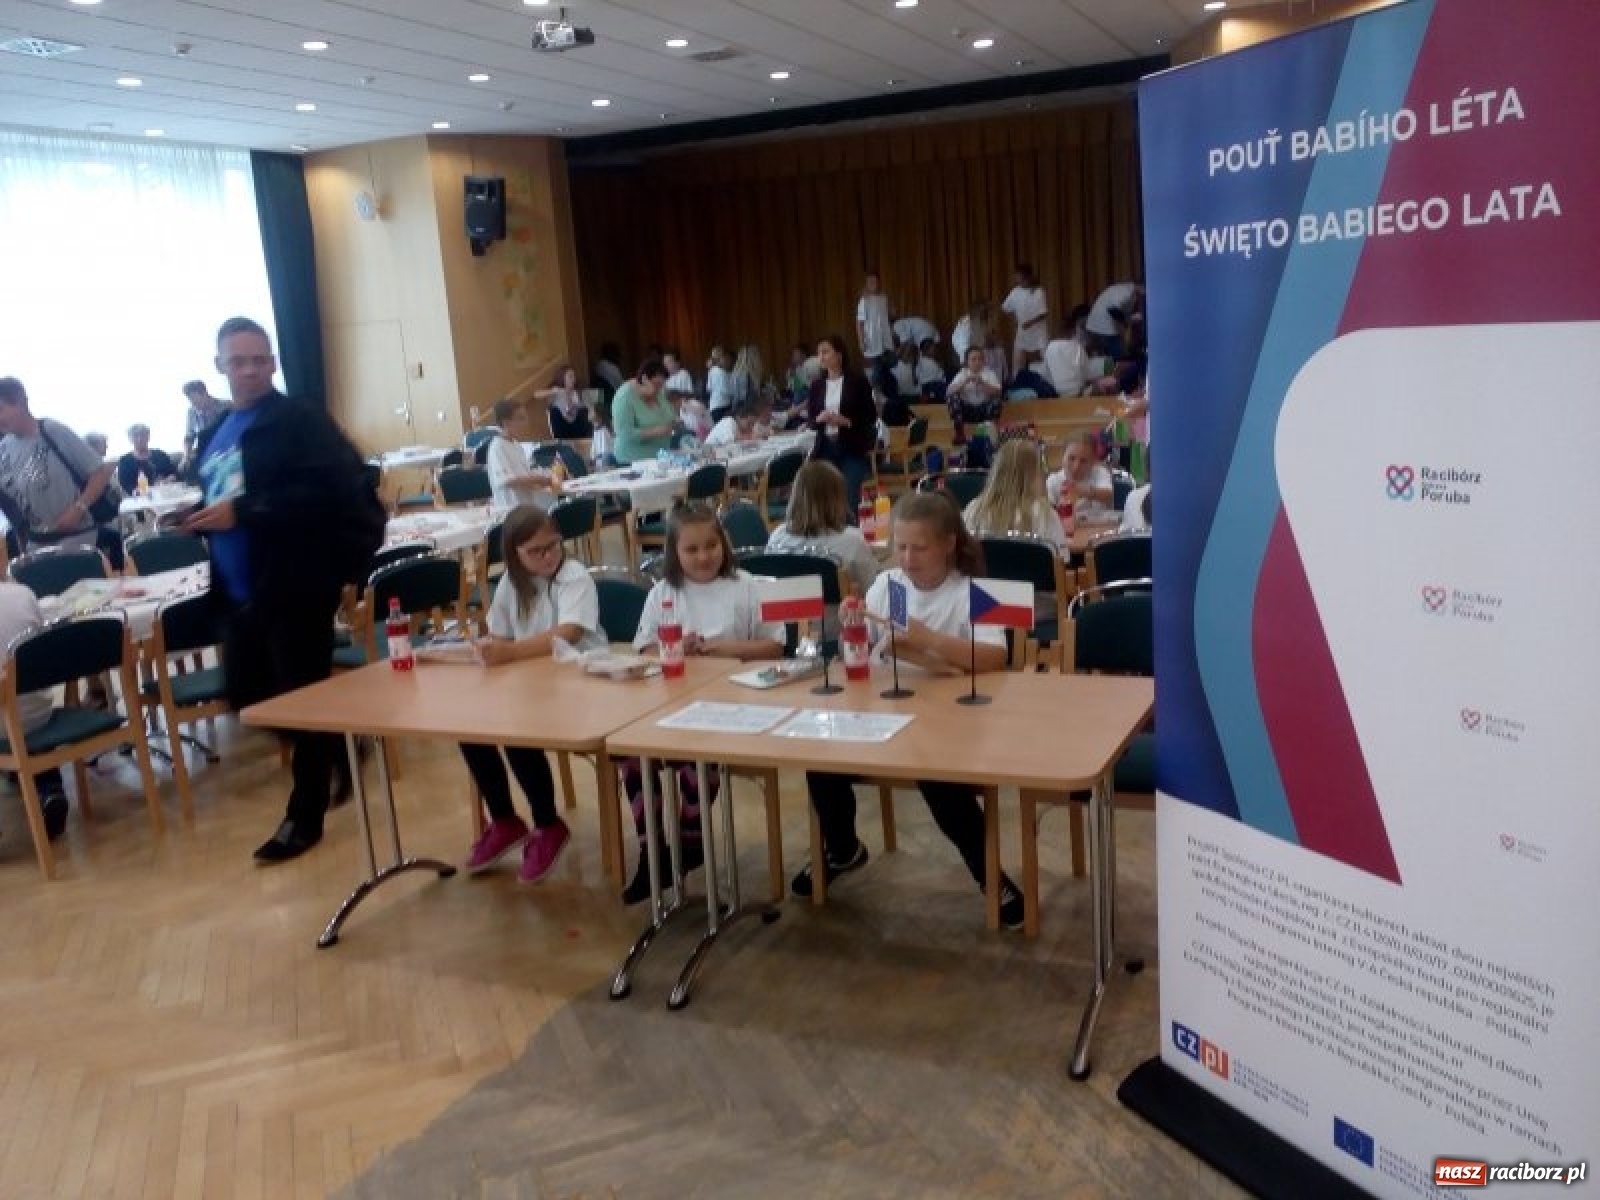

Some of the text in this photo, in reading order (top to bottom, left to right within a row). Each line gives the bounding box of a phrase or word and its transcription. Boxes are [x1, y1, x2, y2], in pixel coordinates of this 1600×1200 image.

[1208, 87, 1525, 176] POUŤ BABÍHO LÉTA
[1183, 182, 1561, 259] ŚWIĘTO BABIEGO LATA
[1421, 466, 1481, 484] Racibórz
[1421, 487, 1471, 504] Poruba
